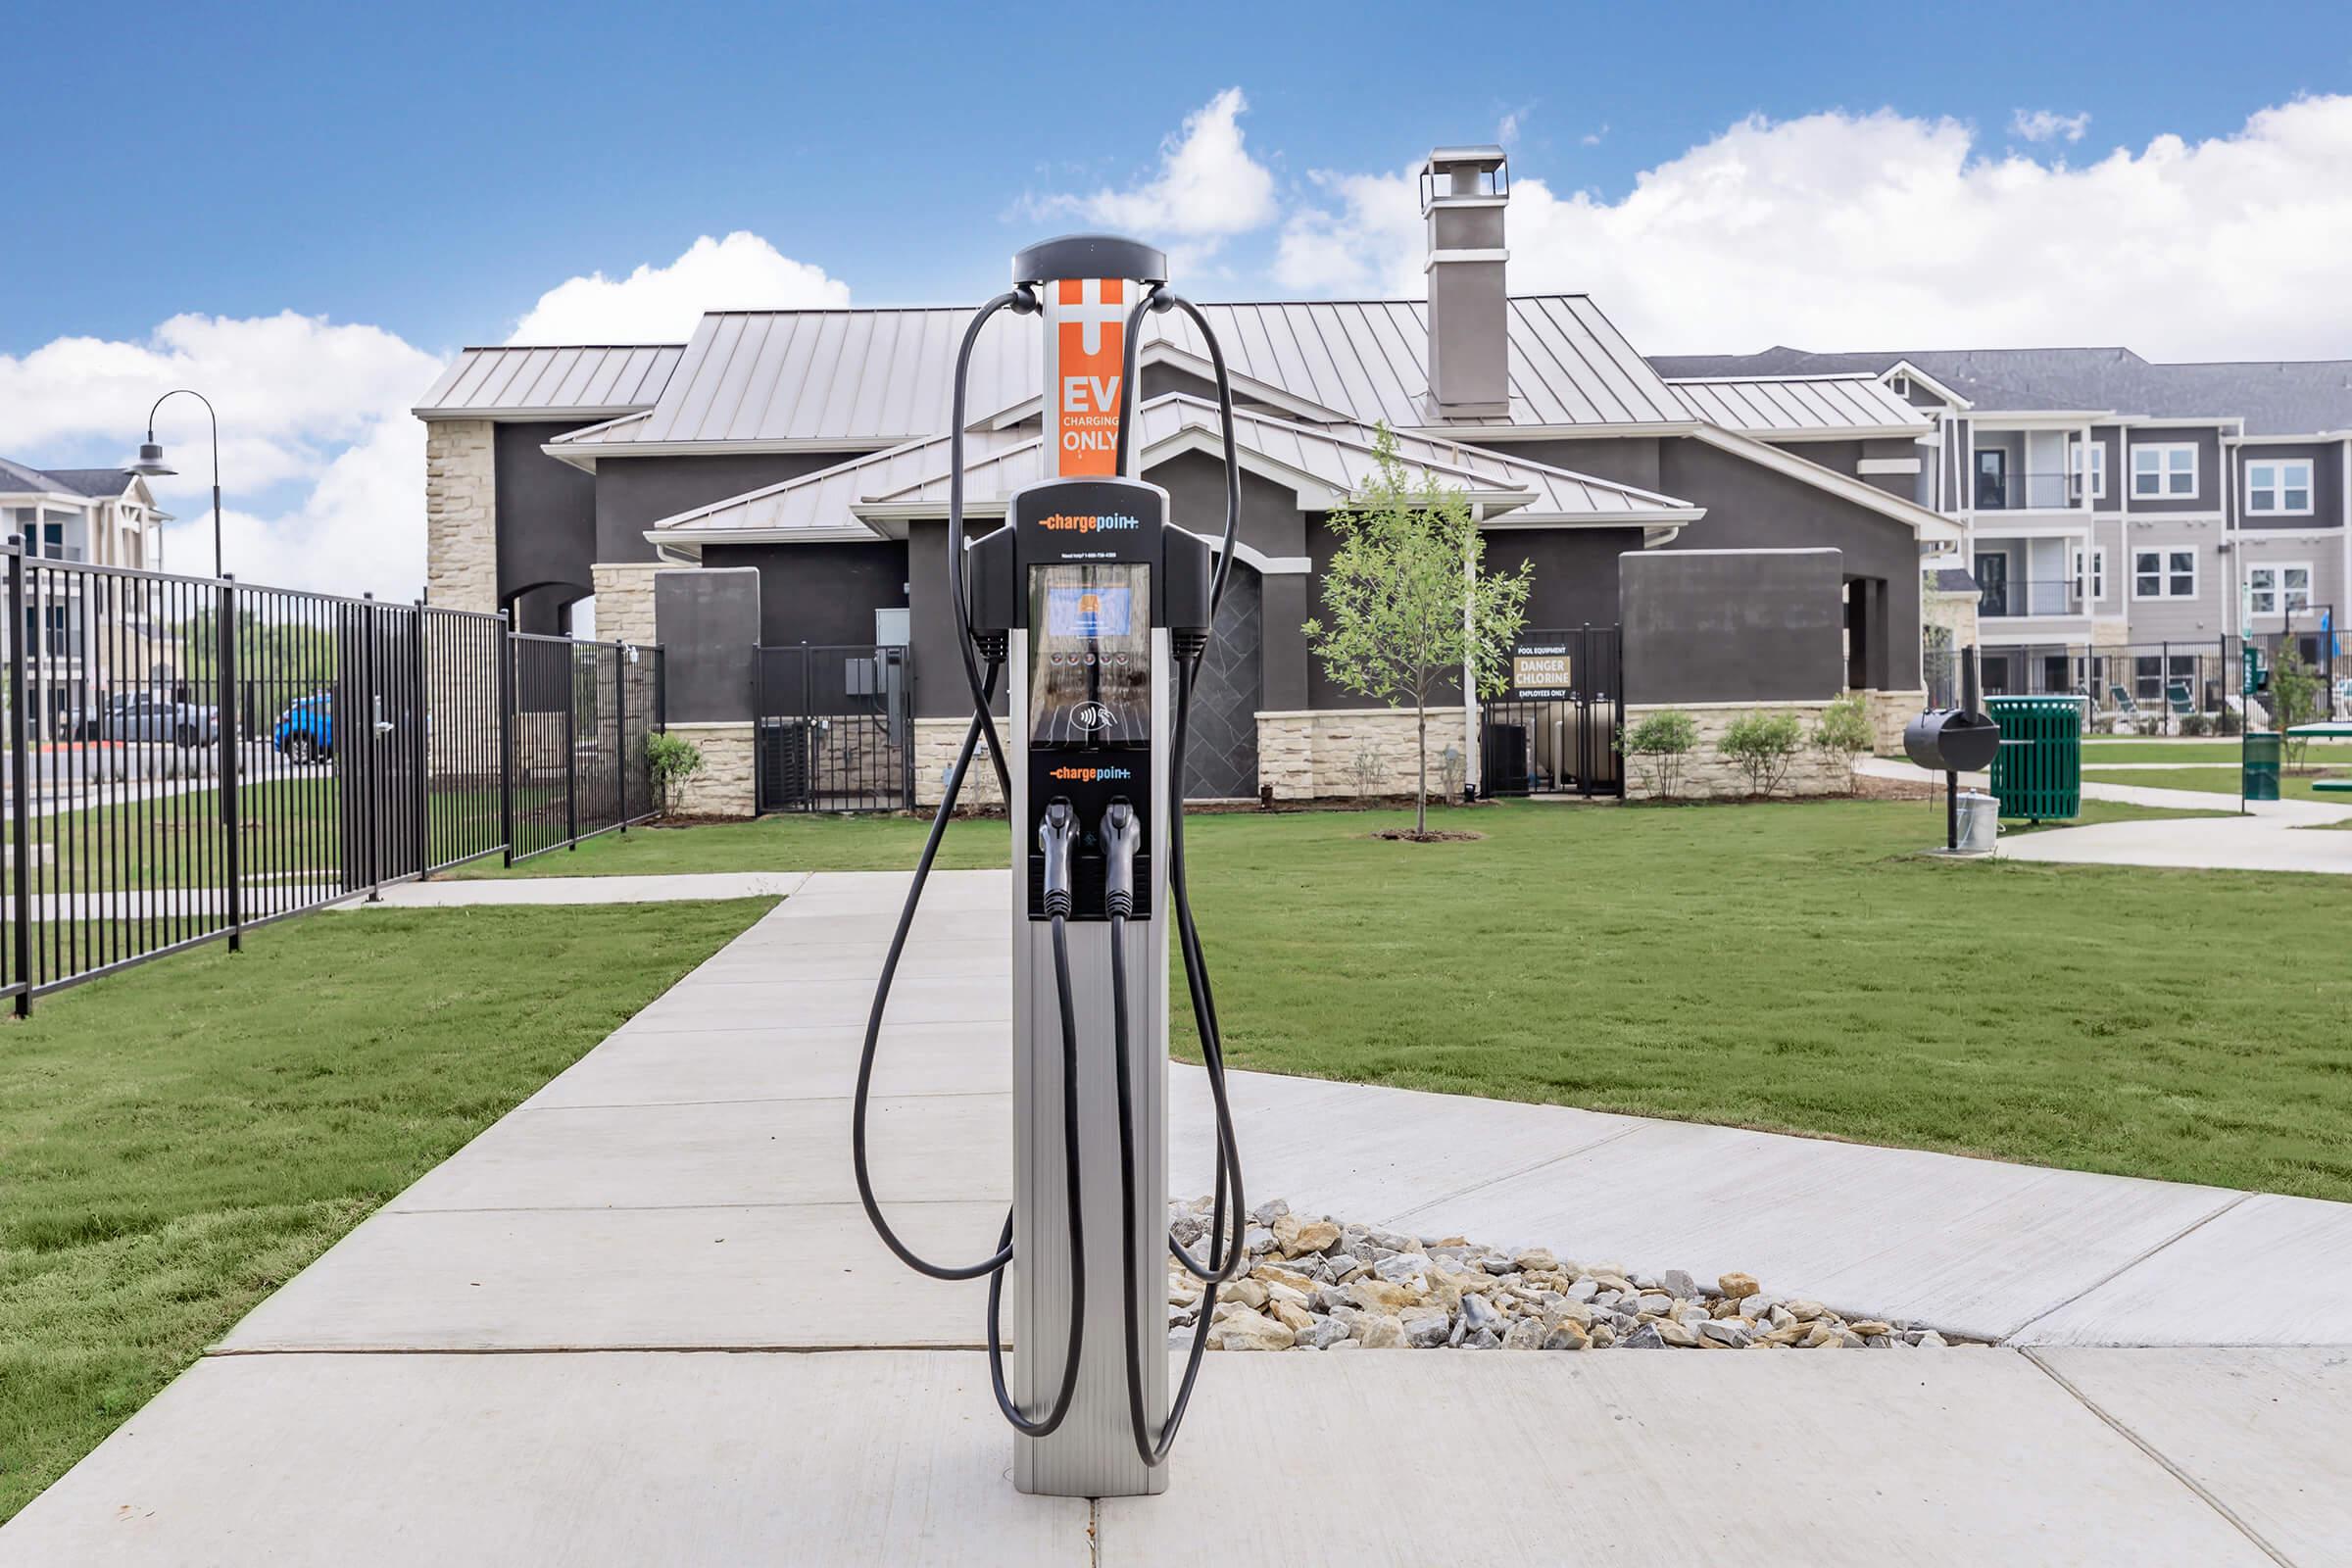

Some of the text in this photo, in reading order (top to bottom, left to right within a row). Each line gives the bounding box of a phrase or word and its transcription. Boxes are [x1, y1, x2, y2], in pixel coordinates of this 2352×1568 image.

[1064, 376, 1120, 412] EV
[1063, 416, 1119, 426] CHARGING
[1063, 431, 1118, 451] ONLY
[1521, 660, 1564, 671] DANGER
[1516, 673, 1569, 683] CHLORINE
